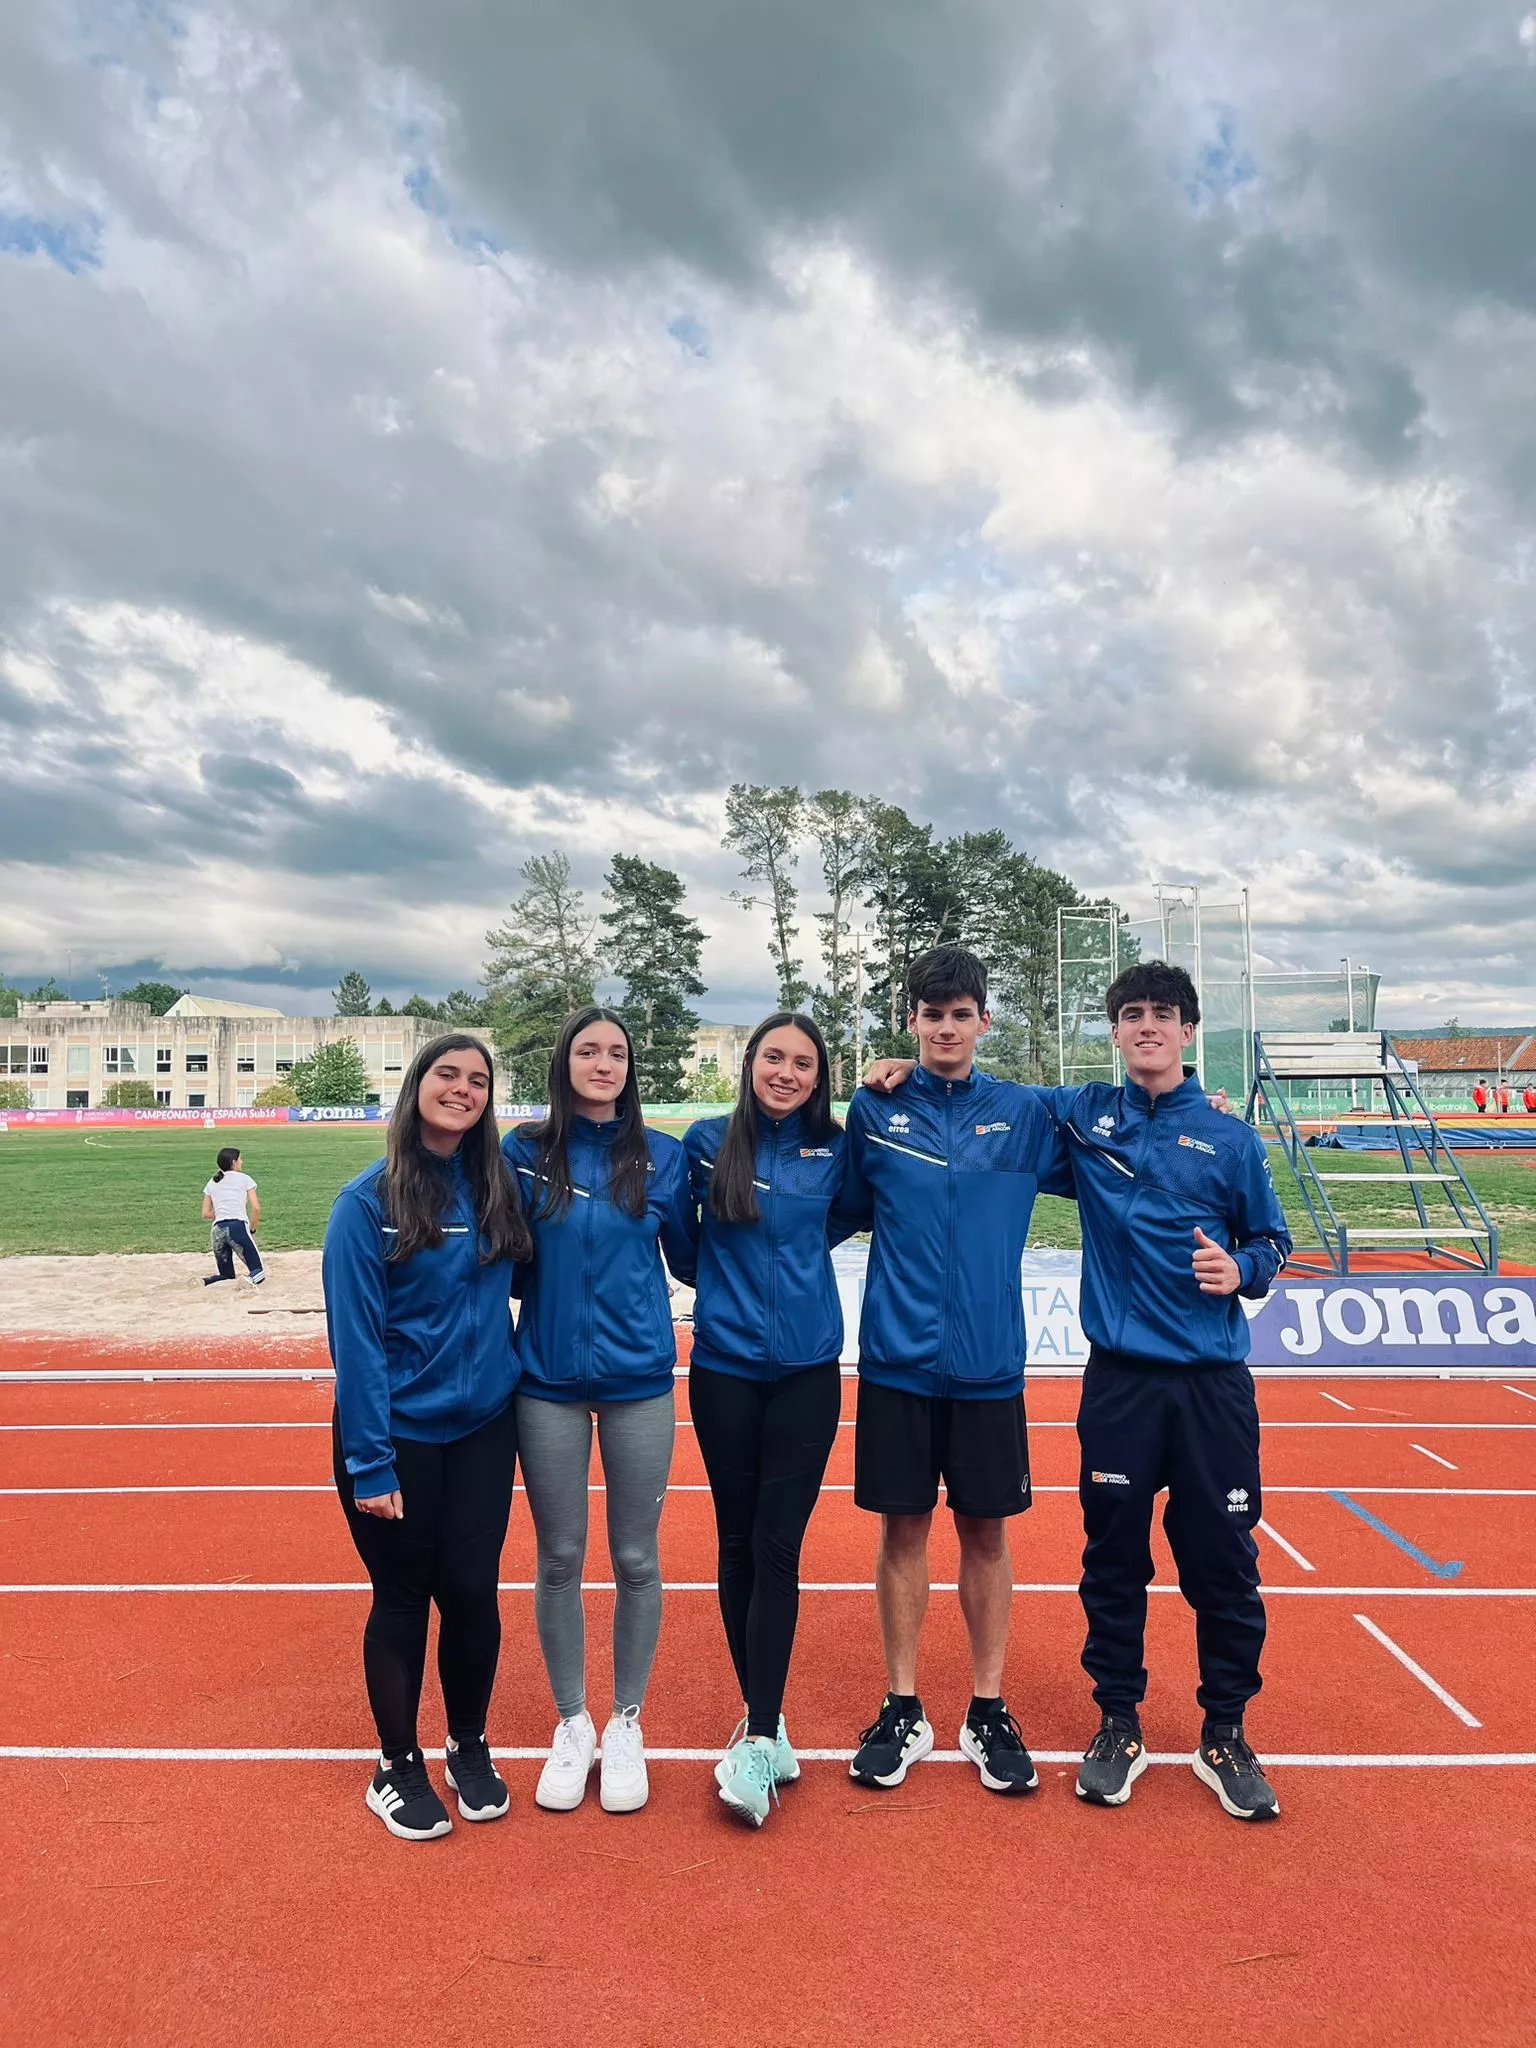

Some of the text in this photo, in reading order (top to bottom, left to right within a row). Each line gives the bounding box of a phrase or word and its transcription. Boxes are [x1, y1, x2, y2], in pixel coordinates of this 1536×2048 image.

[134, 1107, 276, 1120] CAMPEONATO de ESPAÑA Sub16
[1026, 1326, 1085, 1356] AL
